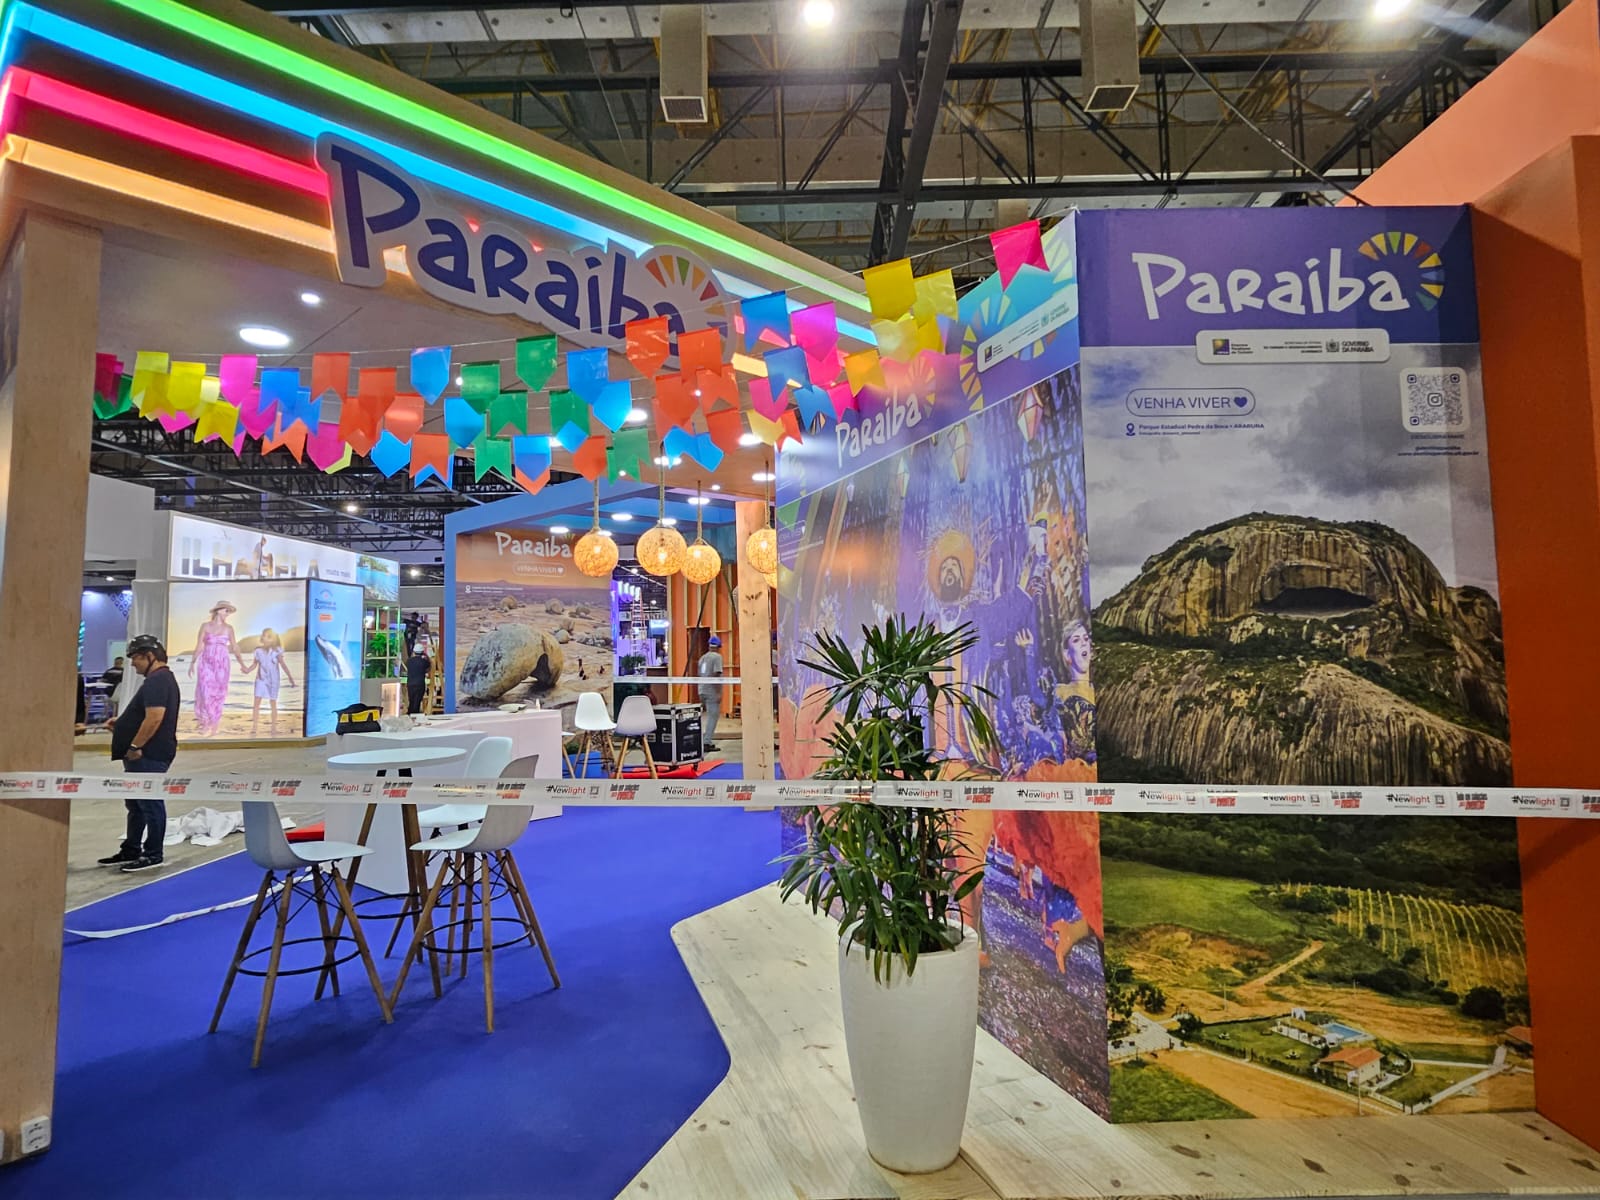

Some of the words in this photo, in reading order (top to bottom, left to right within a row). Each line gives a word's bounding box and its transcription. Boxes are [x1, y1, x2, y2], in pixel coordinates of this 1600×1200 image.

[1134, 398, 1186, 409] VENHA
[1188, 397, 1231, 408] VIVER
[545, 785, 586, 795] #Newlight
[661, 786, 702, 796] #Newlight
[898, 787, 938, 798] #Newlight
[1017, 789, 1059, 800] #Newlight
